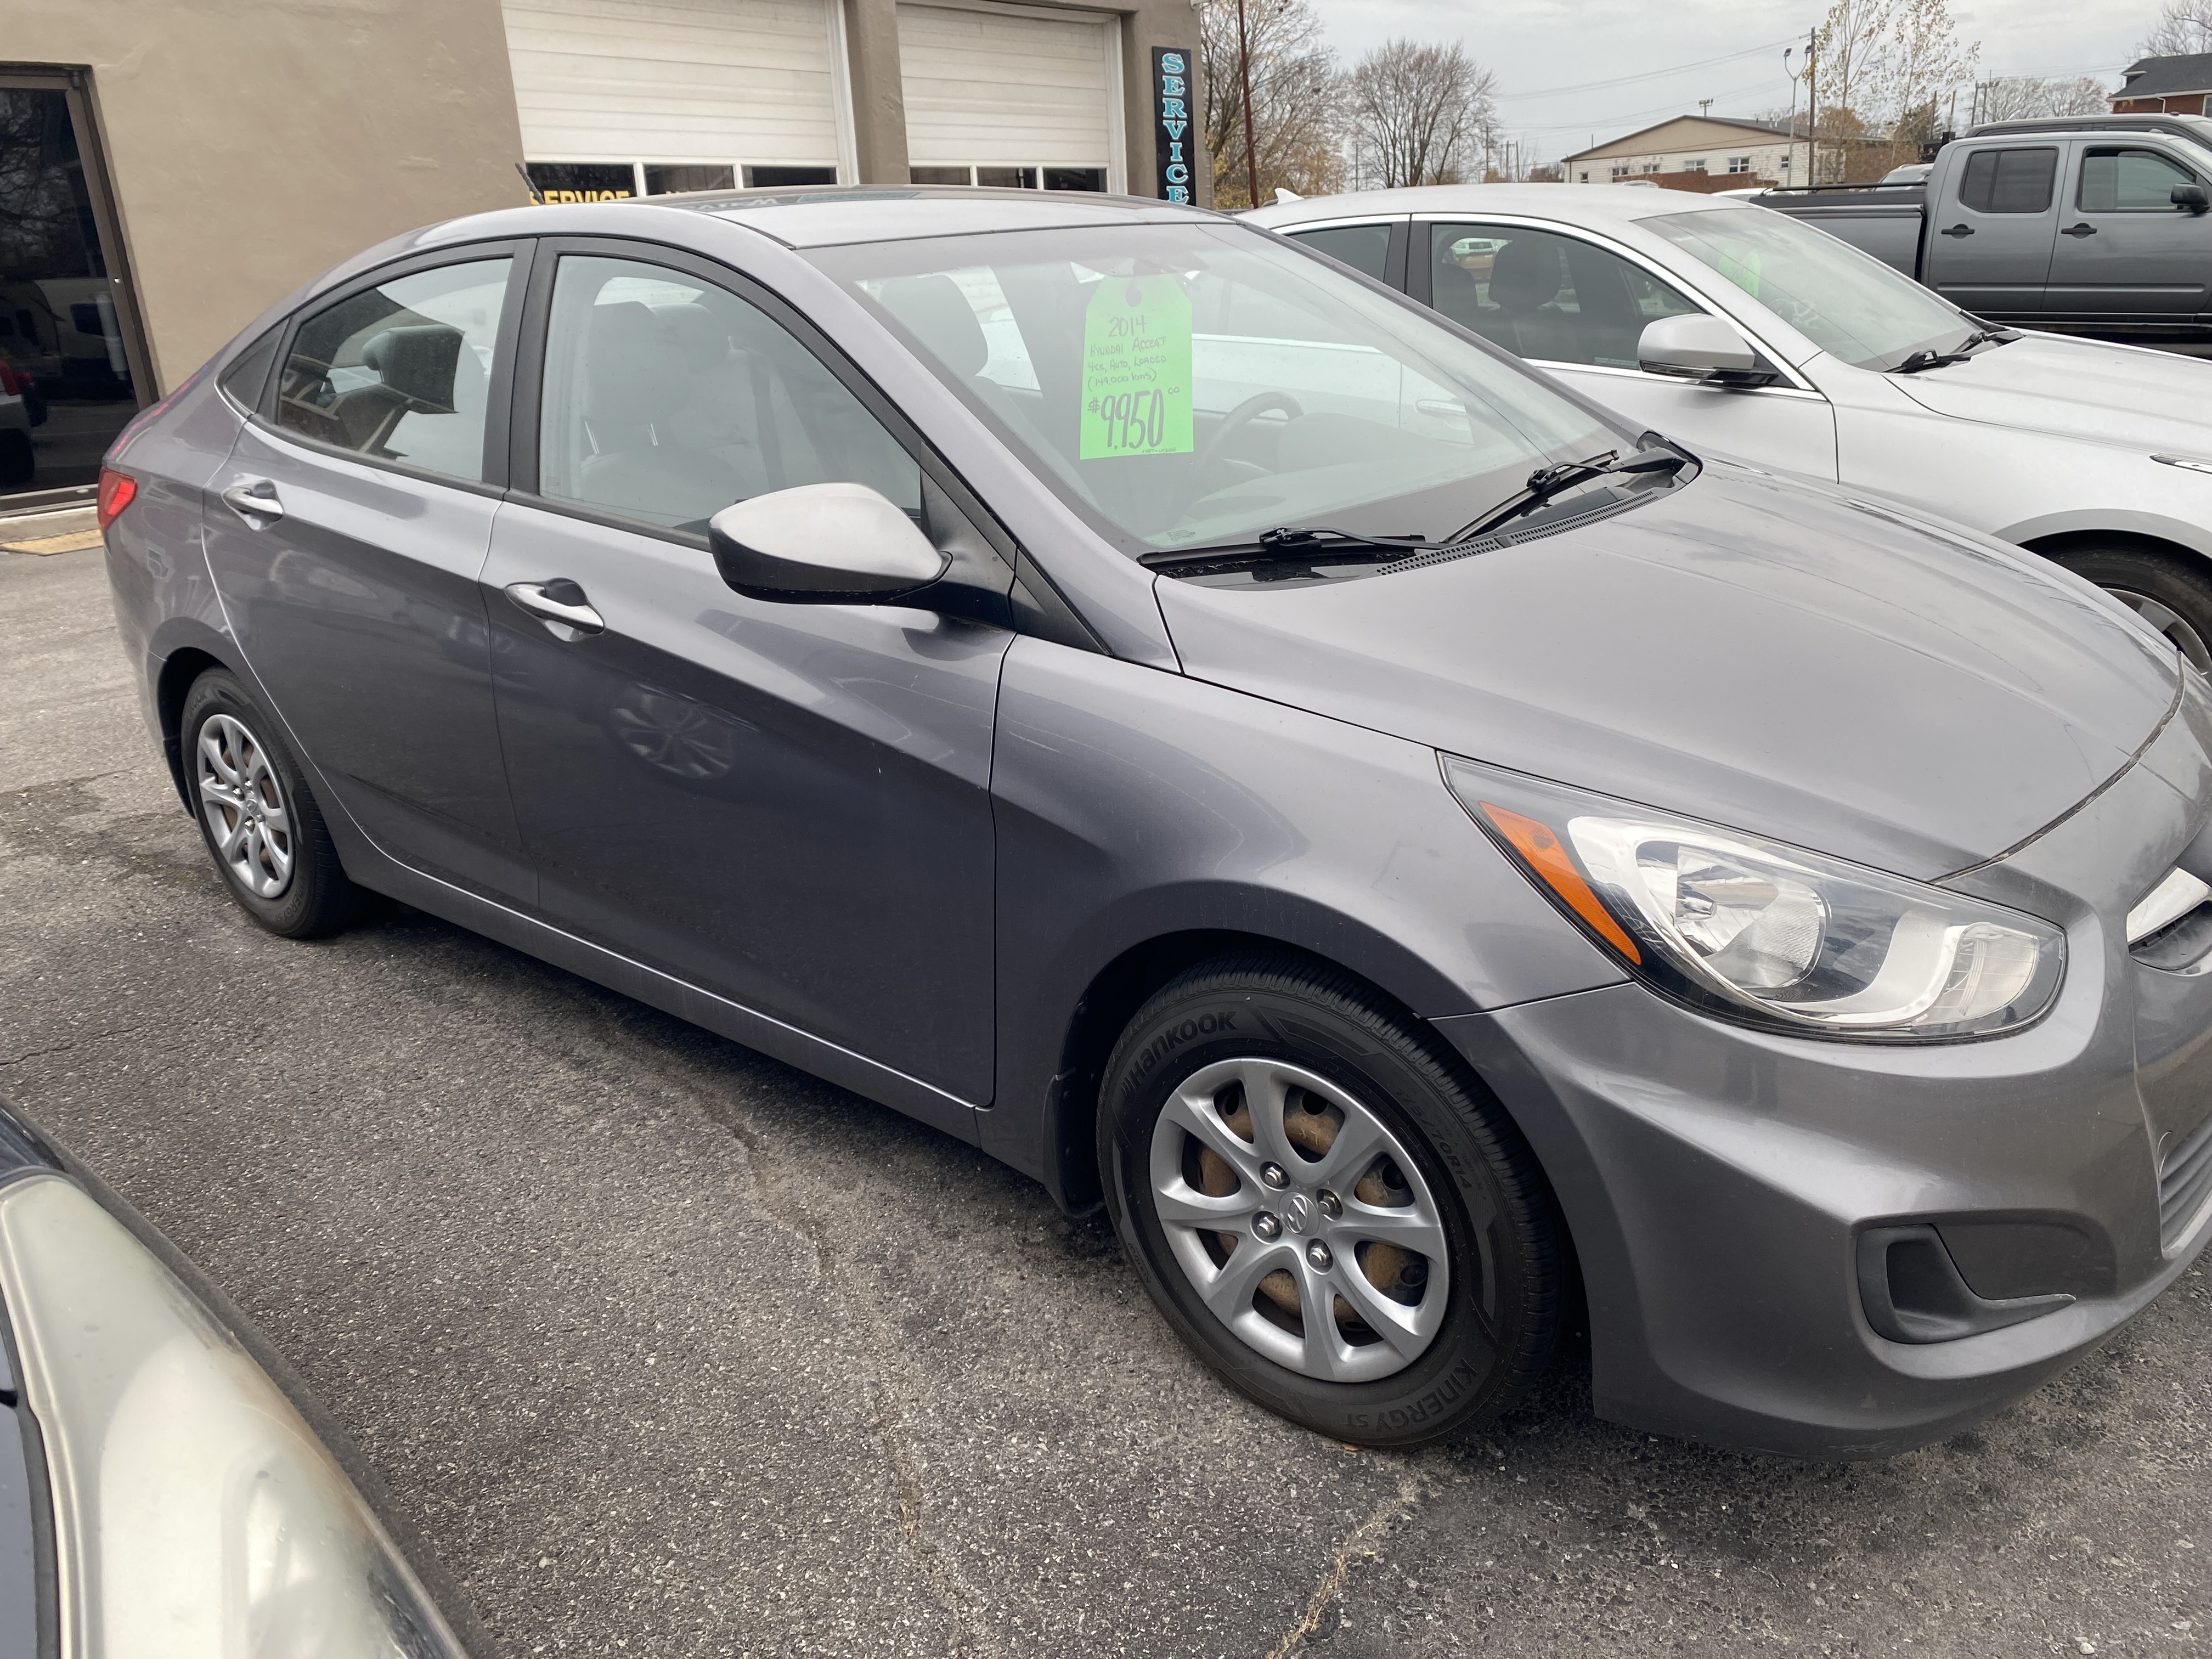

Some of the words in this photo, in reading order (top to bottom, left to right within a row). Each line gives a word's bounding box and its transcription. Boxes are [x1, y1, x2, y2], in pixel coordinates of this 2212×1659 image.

[1161, 53, 1189, 204] SERVICE
[1109, 314, 1147, 337] 2014
[1090, 343, 1124, 357] HYUNDAI
[1132, 336, 1166, 352] ACCENT
[1134, 355, 1166, 366] LOADED
